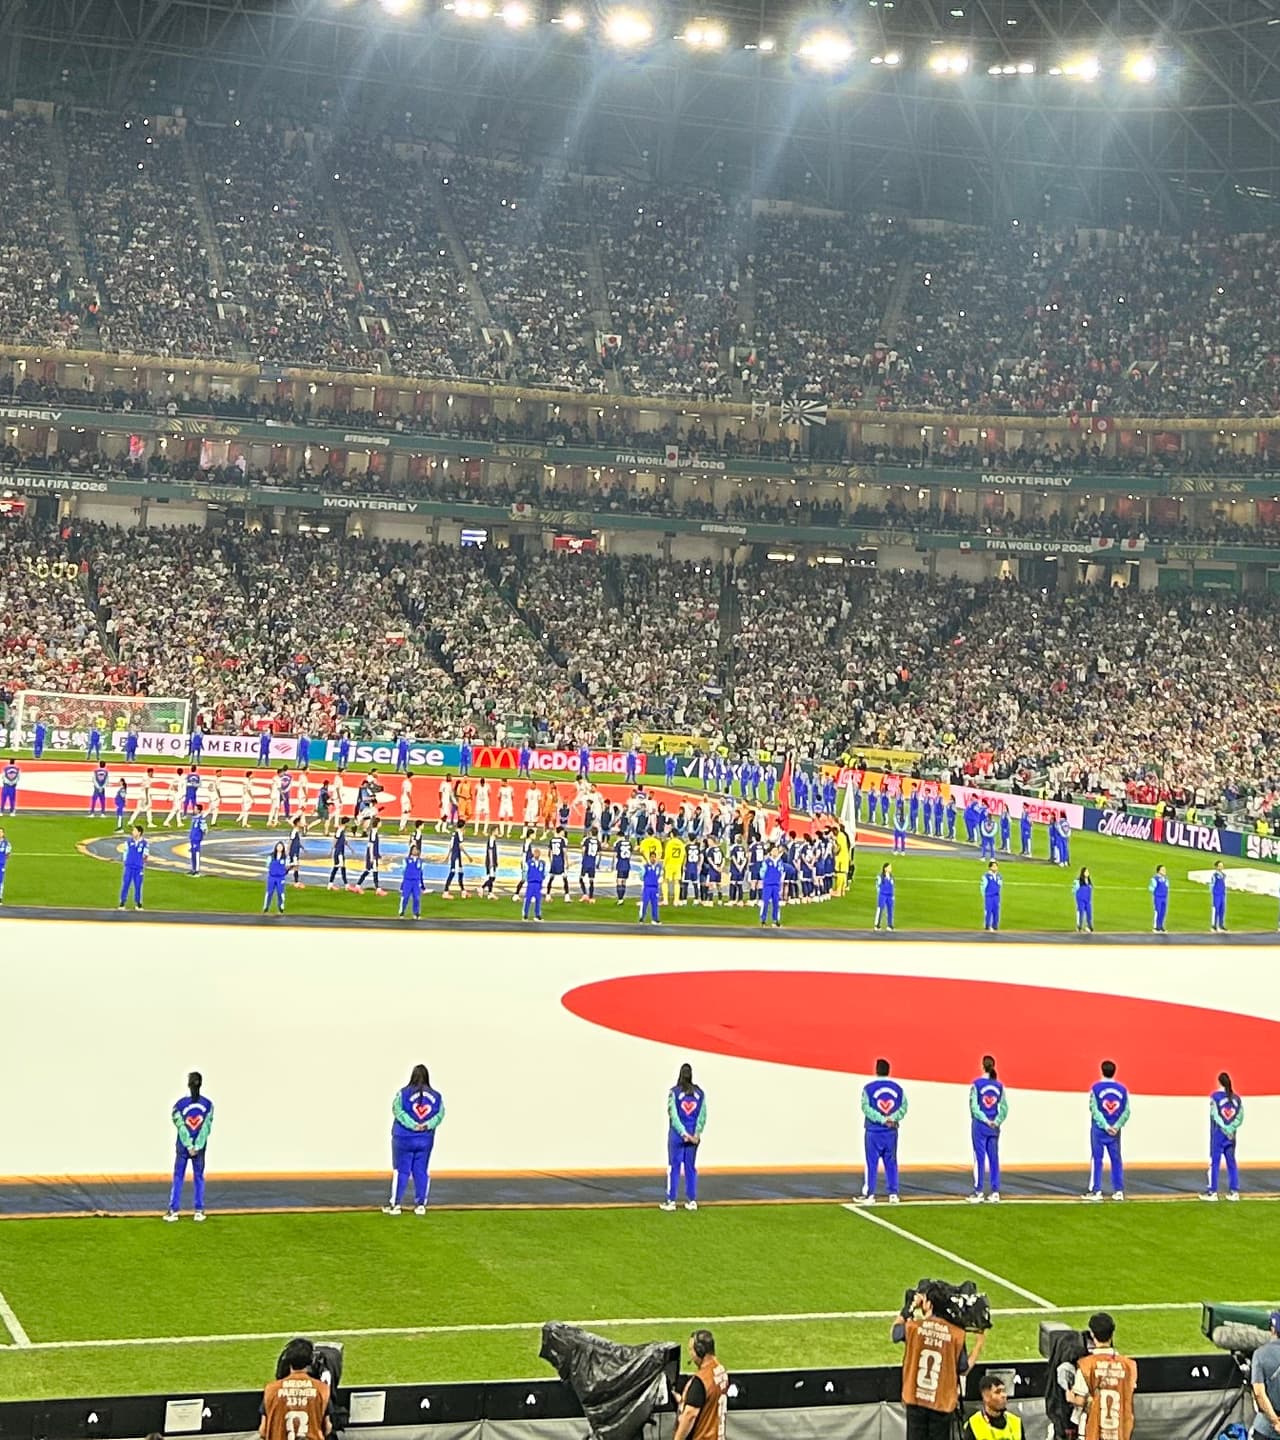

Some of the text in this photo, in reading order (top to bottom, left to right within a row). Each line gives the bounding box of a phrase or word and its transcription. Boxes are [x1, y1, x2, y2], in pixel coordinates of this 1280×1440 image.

[616, 454, 637, 465] FIFA
[17, 477, 31, 487] DE
[32, 478, 46, 488] LA
[47, 479, 69, 490] FIFA
[981, 474, 1072, 487] MONTERREY
[323, 497, 418, 513] MONTERREY
[986, 539, 1007, 551] FIFA
[1007, 541, 1042, 552] WORLD
[1043, 542, 1061, 552] CUP
[1098, 809, 1222, 852] Michelob ULTRA
[917, 1328, 952, 1342] PARTNER
[277, 1388, 318, 1398] PARTNER
